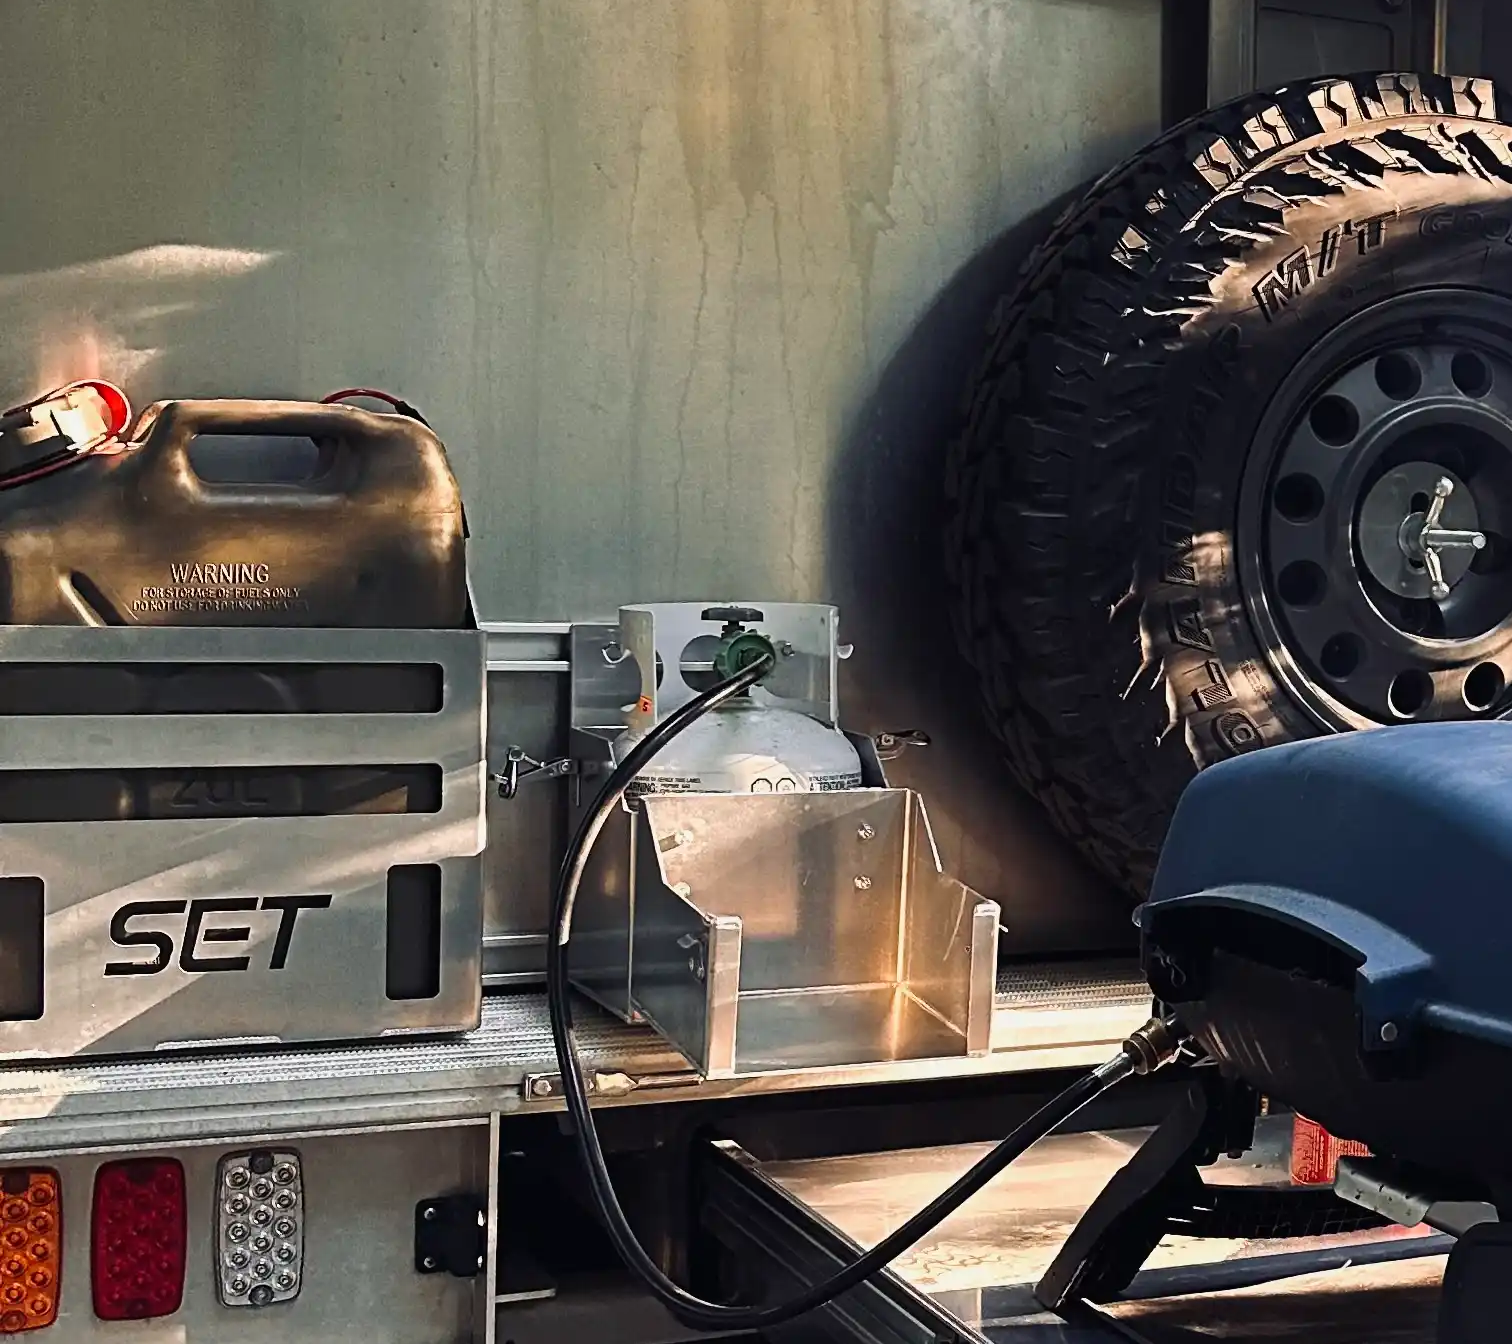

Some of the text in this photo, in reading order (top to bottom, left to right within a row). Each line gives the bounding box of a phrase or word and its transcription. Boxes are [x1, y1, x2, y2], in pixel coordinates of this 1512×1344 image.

[170, 562, 271, 585] WARNING
[141, 587, 162, 599] FOR
[164, 587, 216, 599] STORAGE
[273, 587, 301, 599] ONLY
[103, 894, 333, 977] SET
